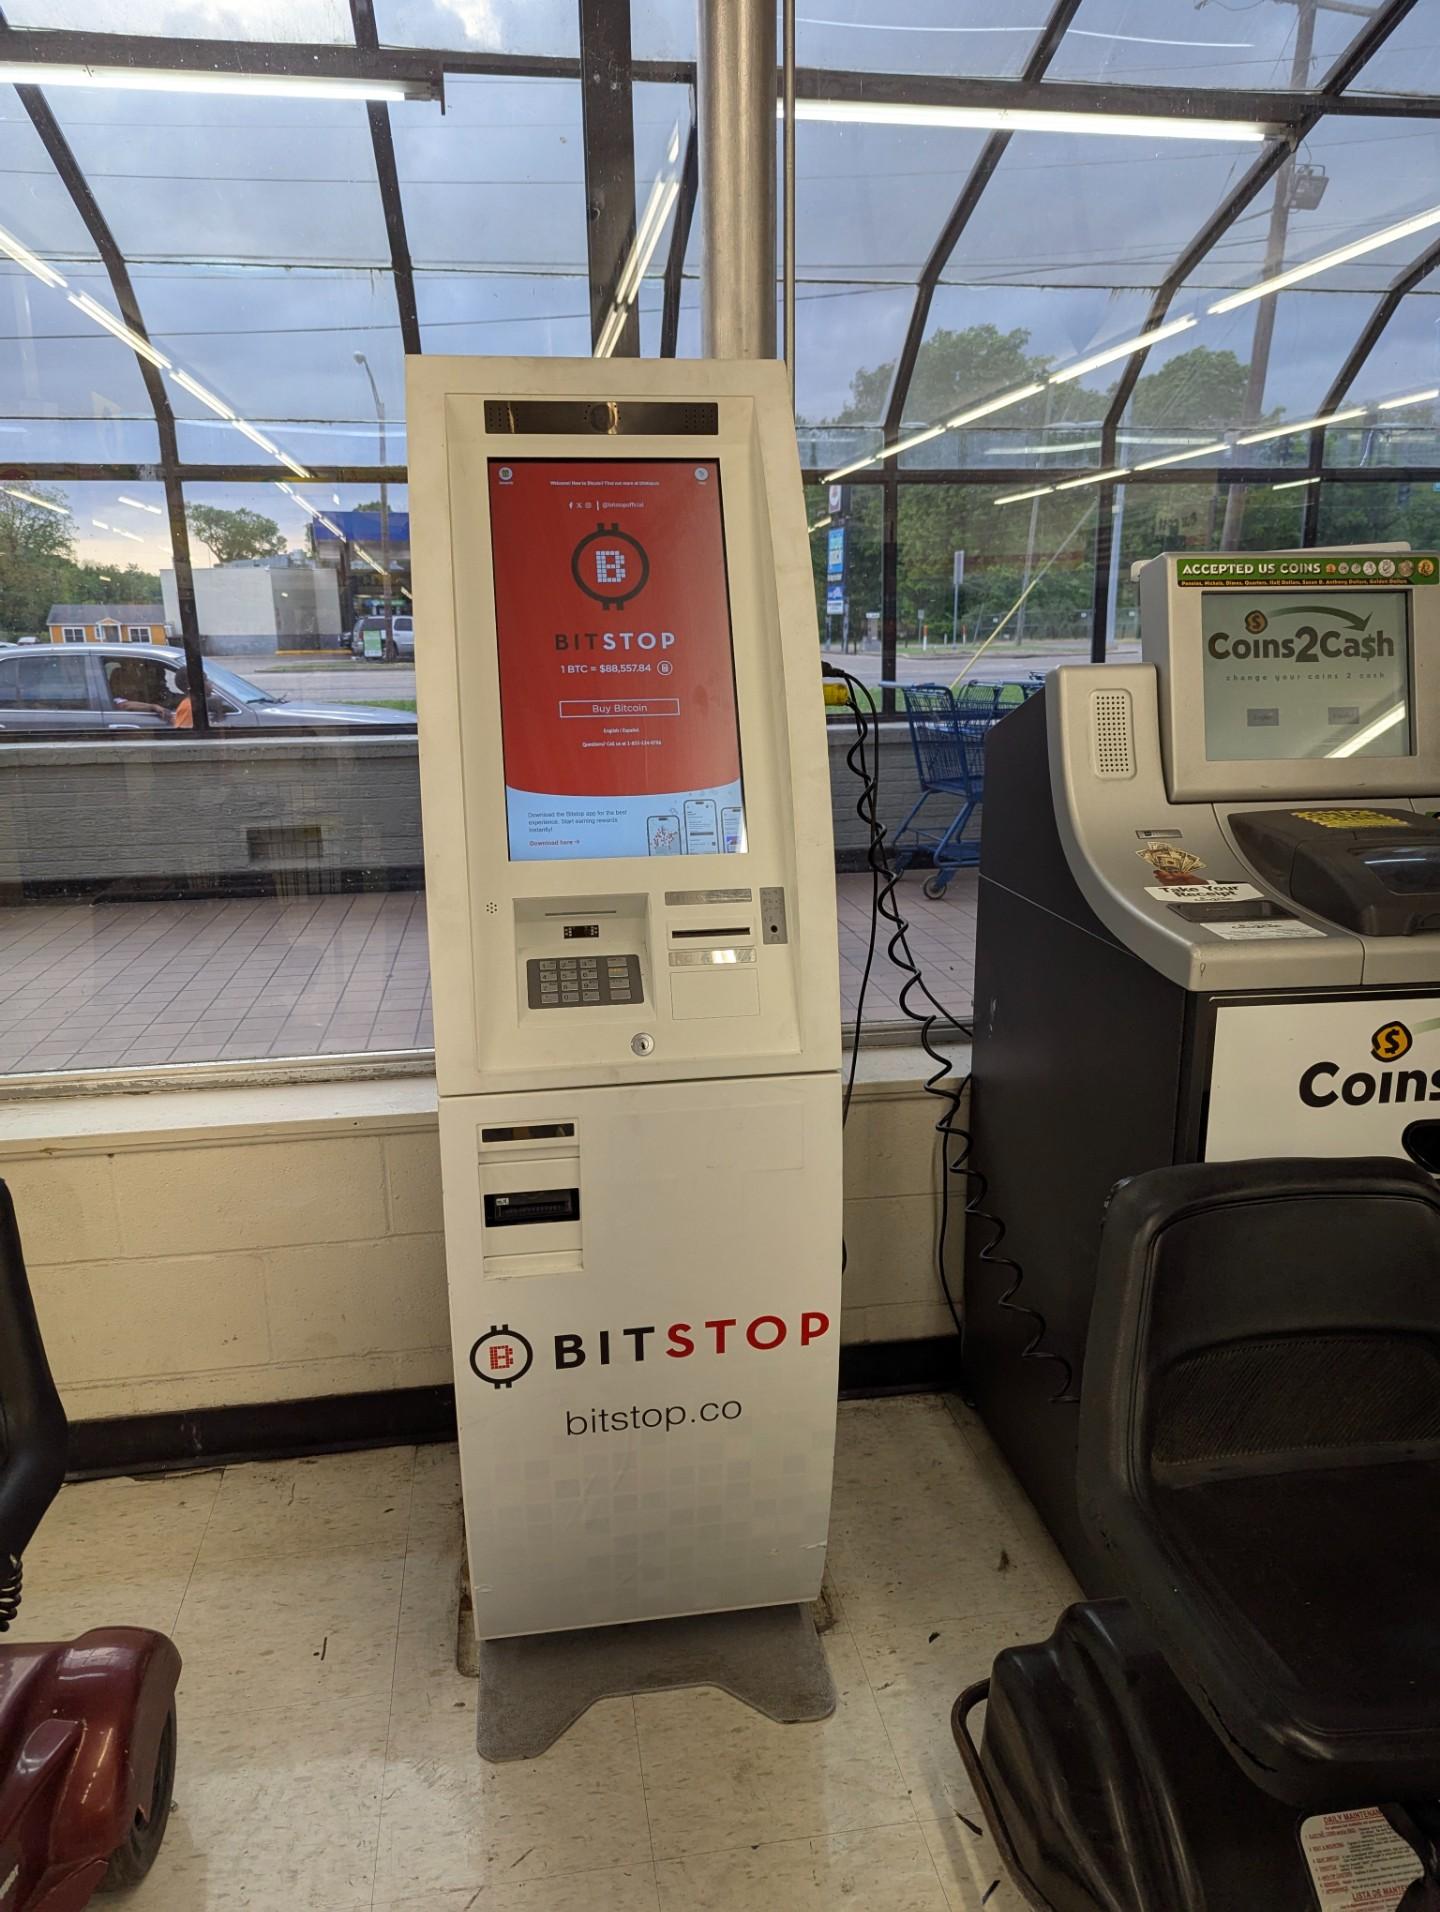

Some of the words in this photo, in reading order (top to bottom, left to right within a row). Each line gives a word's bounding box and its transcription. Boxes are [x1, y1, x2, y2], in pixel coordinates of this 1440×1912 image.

[1182, 563, 1254, 576] ACCEPTED
[1258, 563, 1276, 575] US
[1280, 562, 1321, 575] COINS
[555, 632, 675, 651] BITSTOP
[567, 665, 588, 674] BTC
[1226, 672, 1268, 682] change
[1274, 672, 1301, 682] your
[1307, 672, 1339, 681] coins
[1346, 671, 1353, 680] 2
[1359, 671, 1385, 680] cash
[592, 704, 611, 714] Buy
[614, 703, 648, 713] Bitcoin
[1159, 886, 1199, 894] Take
[1174, 890, 1238, 899] Receipt
[554, 1311, 829, 1370] BITSTOP
[566, 1400, 743, 1436] bitstop.co
[1323, 1814, 1342, 1825] DAILY
